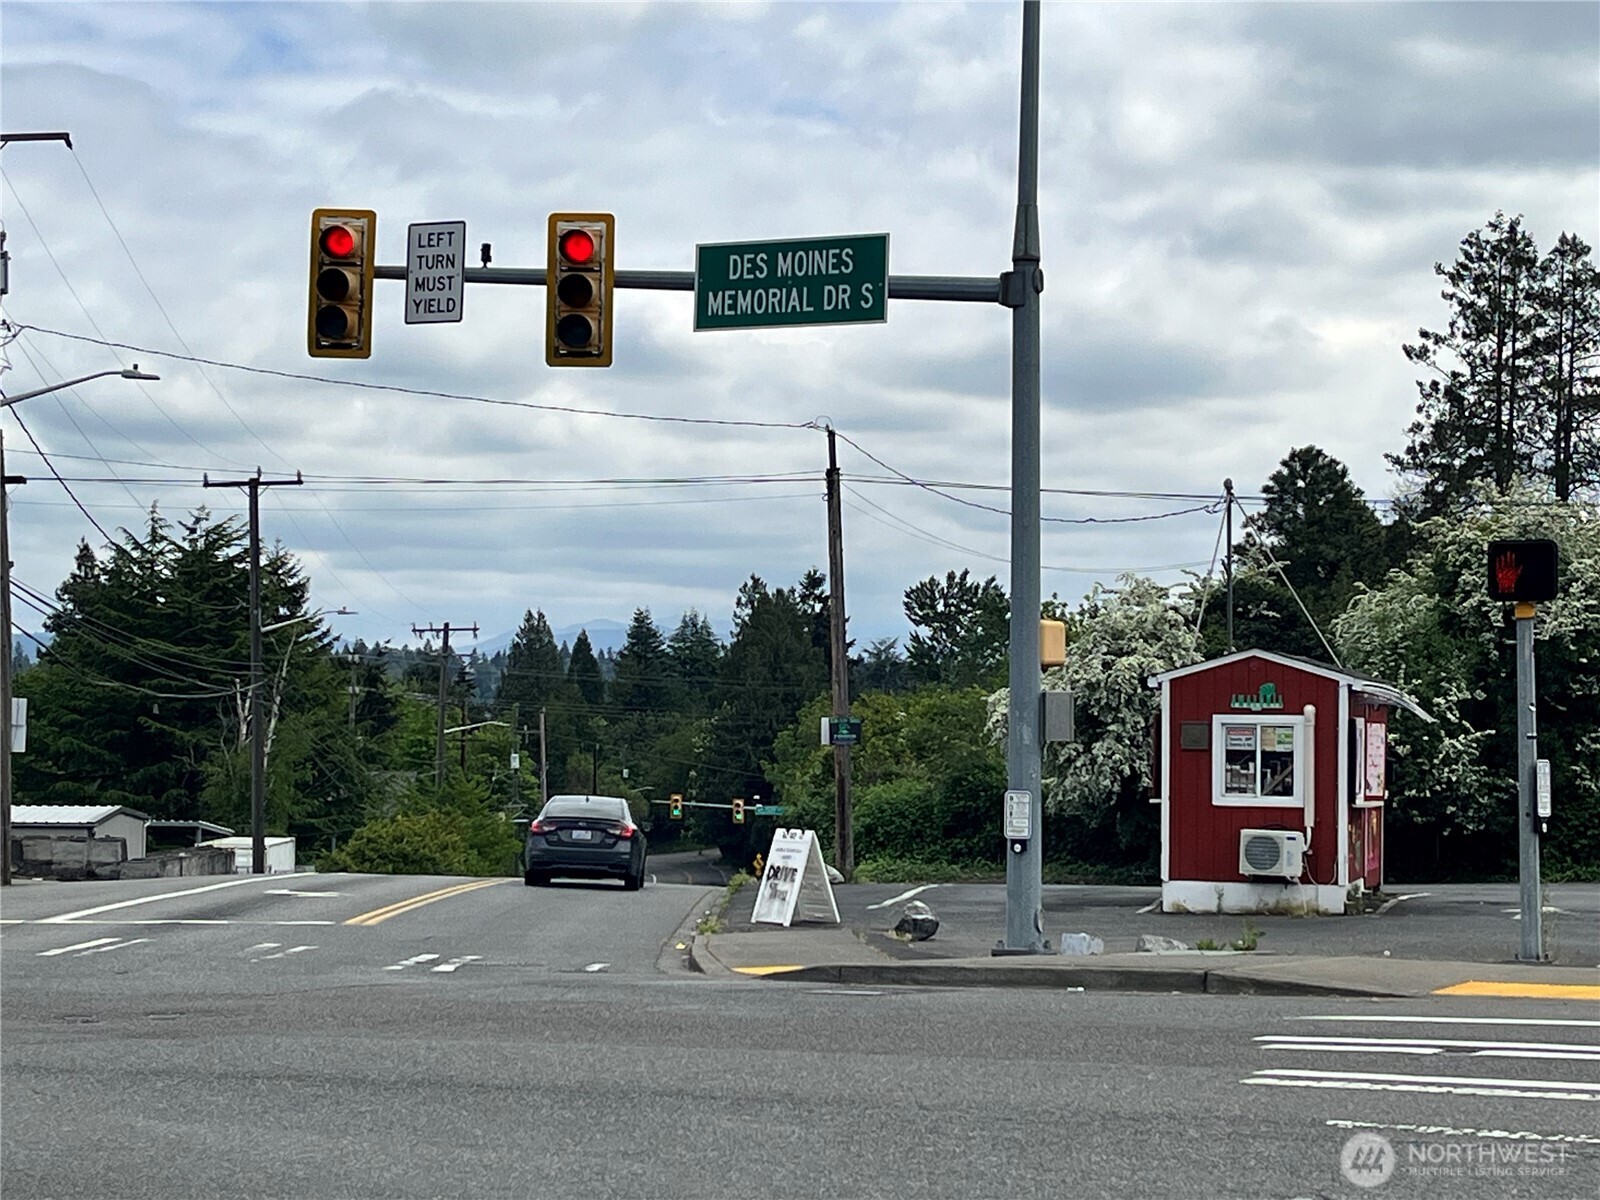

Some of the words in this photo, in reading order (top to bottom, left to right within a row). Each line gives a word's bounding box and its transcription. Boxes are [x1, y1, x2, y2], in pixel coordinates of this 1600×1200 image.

[418, 232, 455, 248] LEFT
[416, 254, 455, 270] TURN
[729, 253, 768, 280] DES
[777, 248, 854, 278] MOINES
[415, 276, 455, 292] MUST
[413, 298, 456, 314] YIELD
[708, 286, 814, 316] MEMORIAL
[823, 284, 851, 311] DR
[860, 282, 874, 309] S
[766, 864, 798, 883] DRIVE
